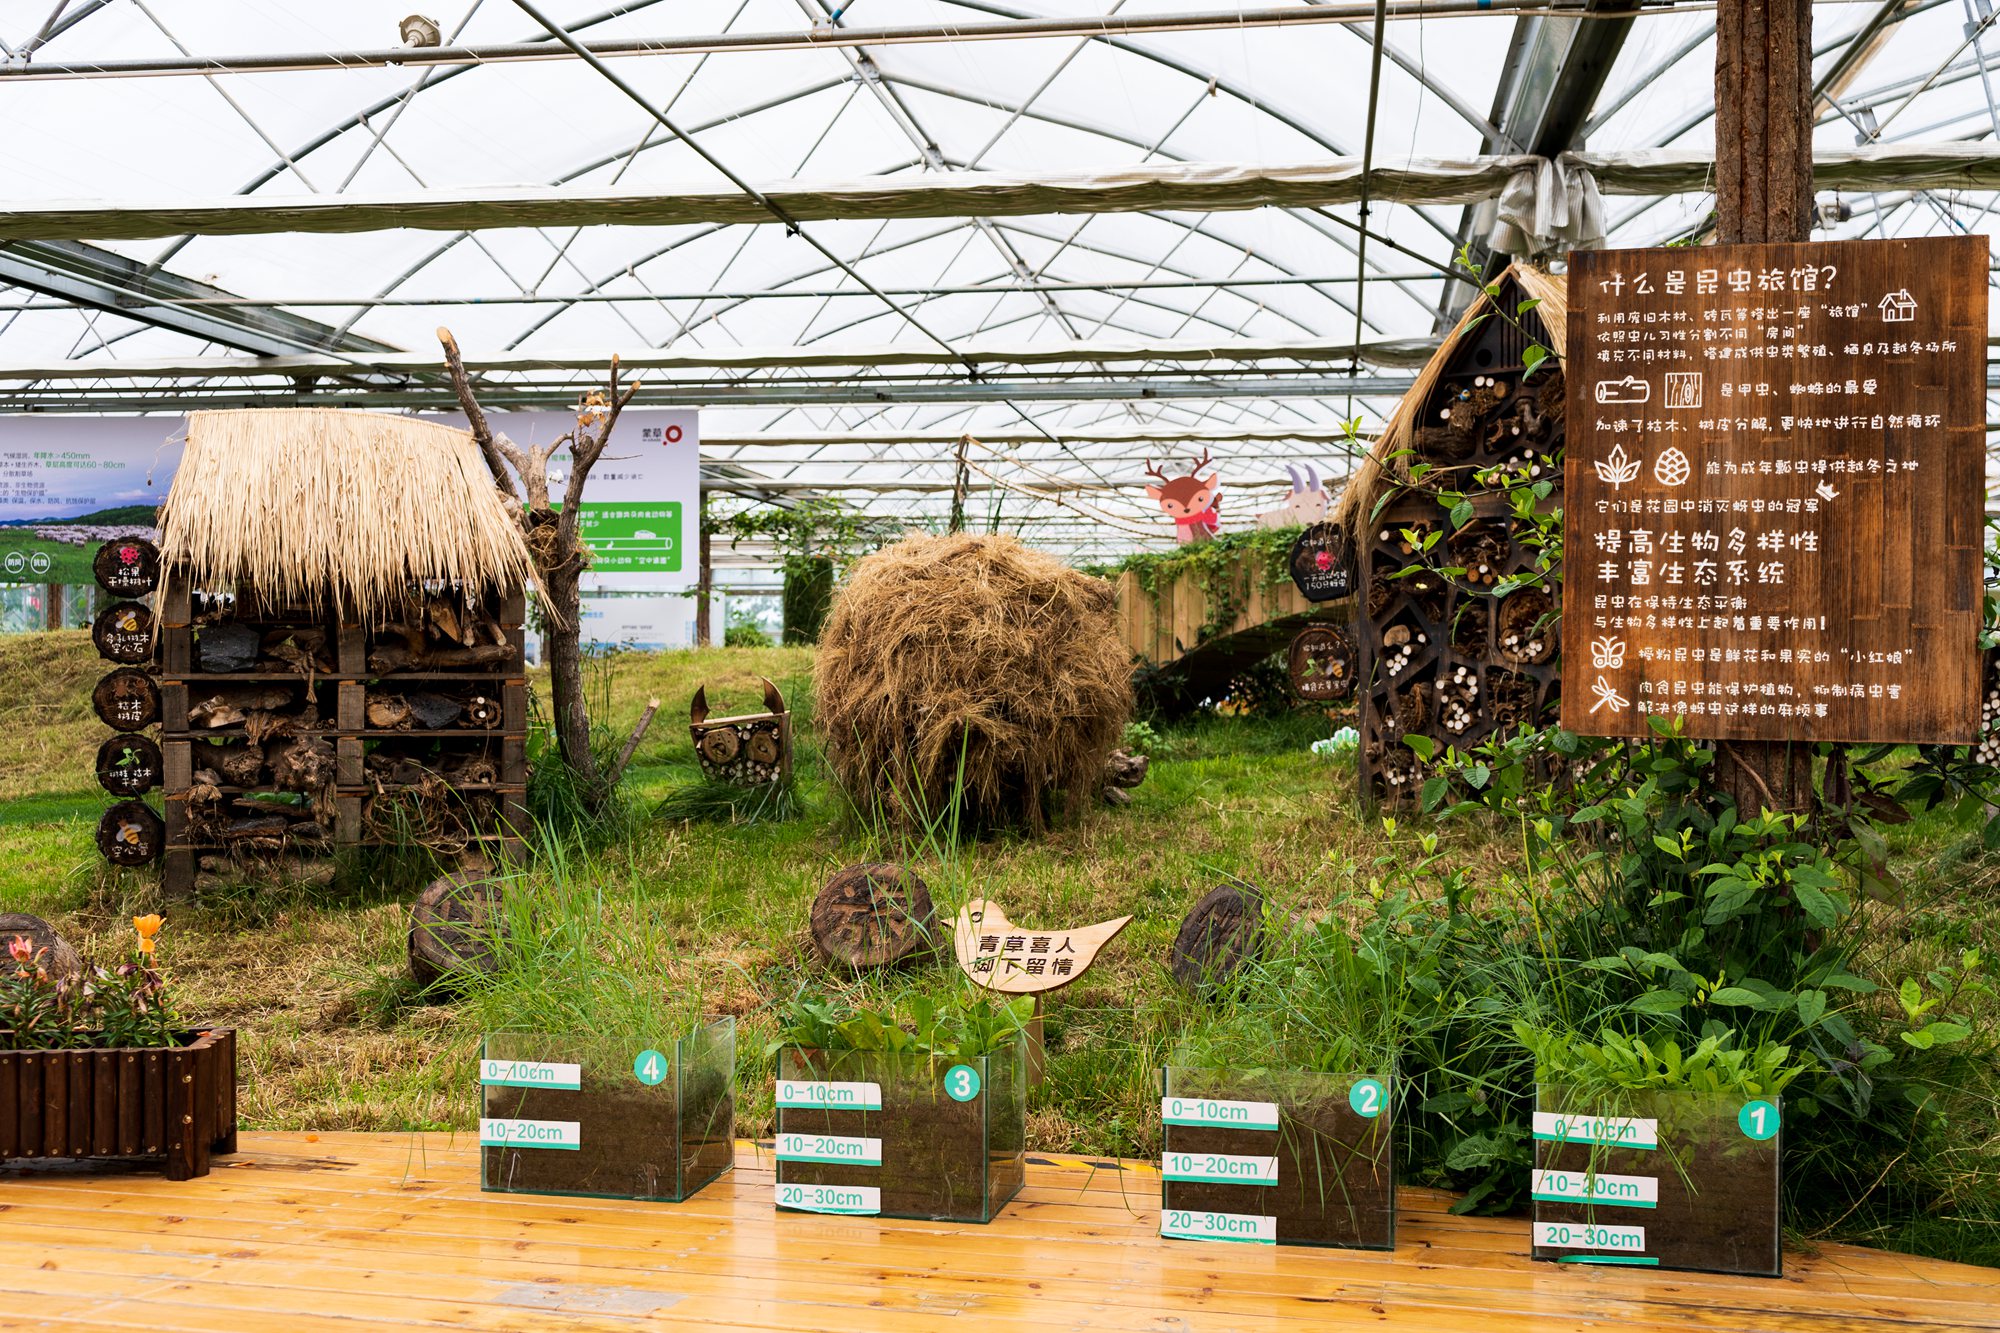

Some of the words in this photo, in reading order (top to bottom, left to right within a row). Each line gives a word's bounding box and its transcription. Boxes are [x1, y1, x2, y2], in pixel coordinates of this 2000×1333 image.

[1599, 263, 1837, 297] 什么是昆虫旅馆?
[1720, 379, 1878, 398] 是甲虫、蜘蛛的最爱
[1706, 458, 1919, 475] 能为成年瓢虫提供越冬之地
[1595, 498, 1819, 514] 它们是花园中消灭蚜虫的冠军
[1594, 526, 1819, 556] 提高生物多样性
[118, 566, 140, 577] 松果
[1597, 558, 1785, 586] 丰富生态系统
[1594, 595, 1747, 610] 昆虫在保持生态平衡
[117, 711, 142, 721] 树皮
[1638, 700, 1829, 717] 解决像蚜虫这样的麻烦事
[979, 935, 1076, 954] 青草喜人
[488, 1062, 554, 1081] 0-10cm
[643, 1055, 660, 1081] 4
[784, 1084, 854, 1102] 0-10cm
[954, 1070, 971, 1098] 3
[1359, 1084, 1380, 1113] 2
[1171, 1100, 1249, 1120] 0-10cm
[1750, 1106, 1767, 1135] 1
[487, 1122, 563, 1140] 10-20cm
[783, 1137, 863, 1156] 10-20cm
[1170, 1155, 1258, 1175] 10-20cm
[783, 1187, 863, 1206] 20-30cm
[1169, 1211, 1257, 1233] 20-30cm
[1546, 1226, 1642, 1248] 20-30cm
